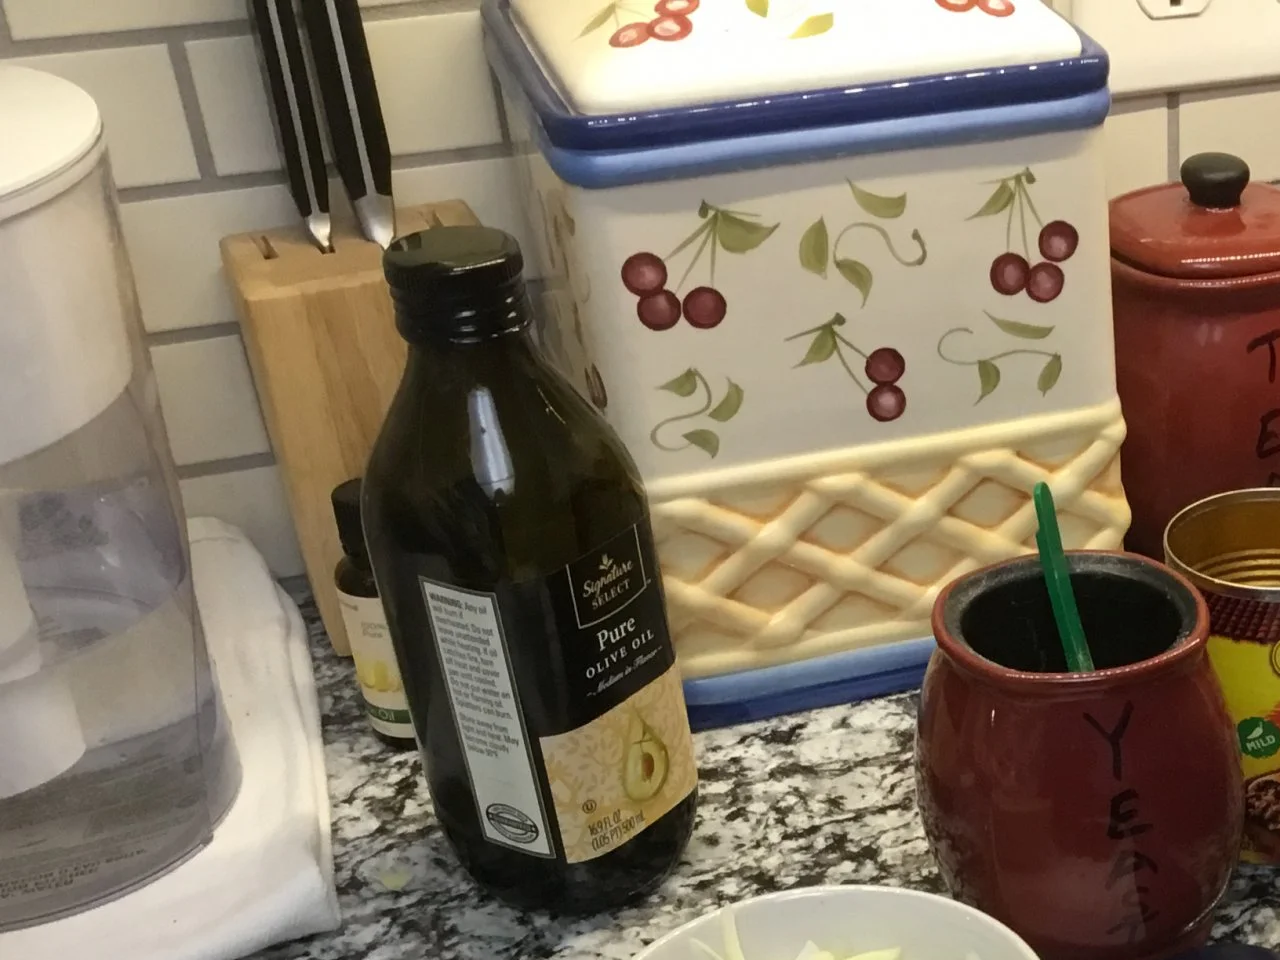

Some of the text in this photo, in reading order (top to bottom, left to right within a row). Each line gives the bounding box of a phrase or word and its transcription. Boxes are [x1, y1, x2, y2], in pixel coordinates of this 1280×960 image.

[582, 559, 634, 599] Signature
[592, 578, 631, 610] SELECT
[596, 617, 636, 652] Pure
[586, 629, 655, 679] OLIVE OIL
[1246, 734, 1276, 752] MILD
